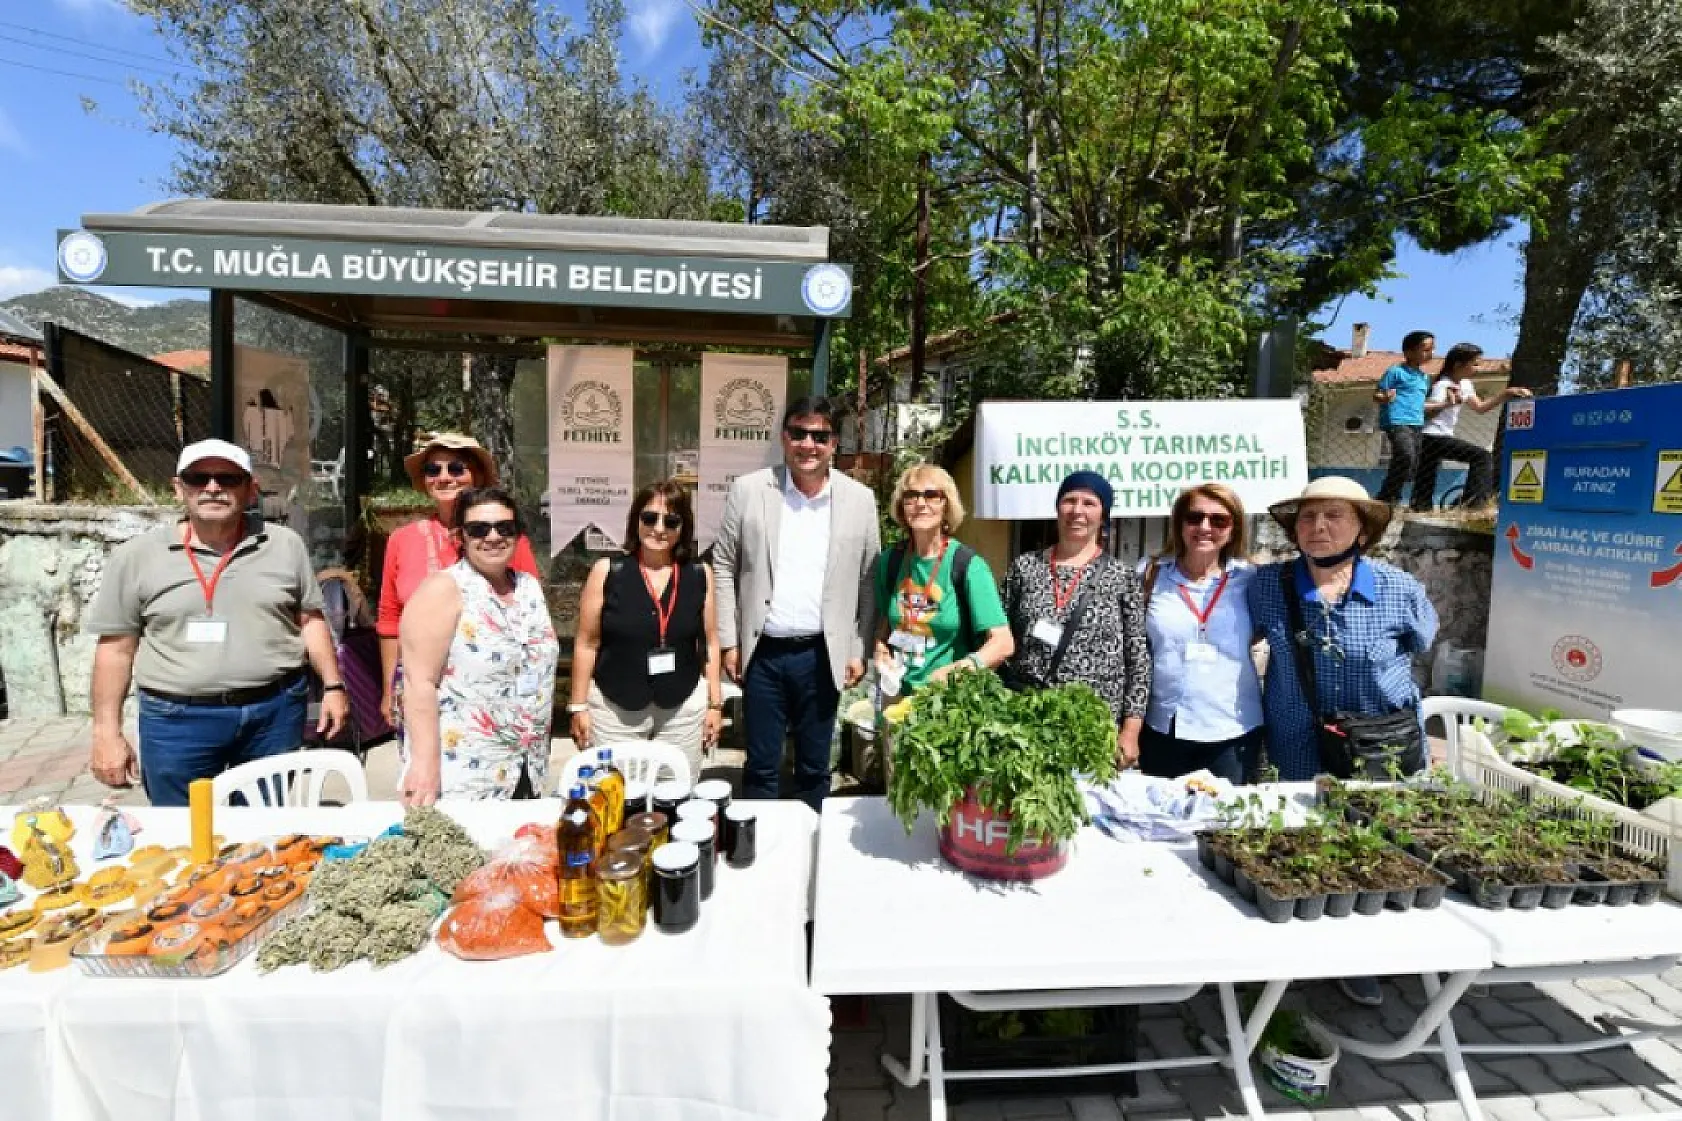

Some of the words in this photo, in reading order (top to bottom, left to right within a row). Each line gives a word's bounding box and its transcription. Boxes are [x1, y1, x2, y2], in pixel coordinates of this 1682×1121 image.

[146, 247, 202, 274] T.C.
[213, 245, 332, 278] MUĞLA
[342, 248, 558, 292] BÜYÜKŞEHİR
[568, 263, 763, 300] BELEDİYESİ
[1117, 409, 1161, 428] S.S.
[1016, 432, 1132, 456] İNCİRKÖY
[1139, 433, 1264, 455] TARIMSAL
[1131, 455, 1288, 482] KOOPERATİFİ
[1563, 466, 1631, 478] BURADAN
[1112, 484, 1176, 508] ETHİY
[1572, 481, 1617, 494] ATINIZ
[1592, 530, 1610, 543] VE
[1612, 530, 1665, 550] GÜBRE
[1594, 547, 1660, 564] ATIKLARI
